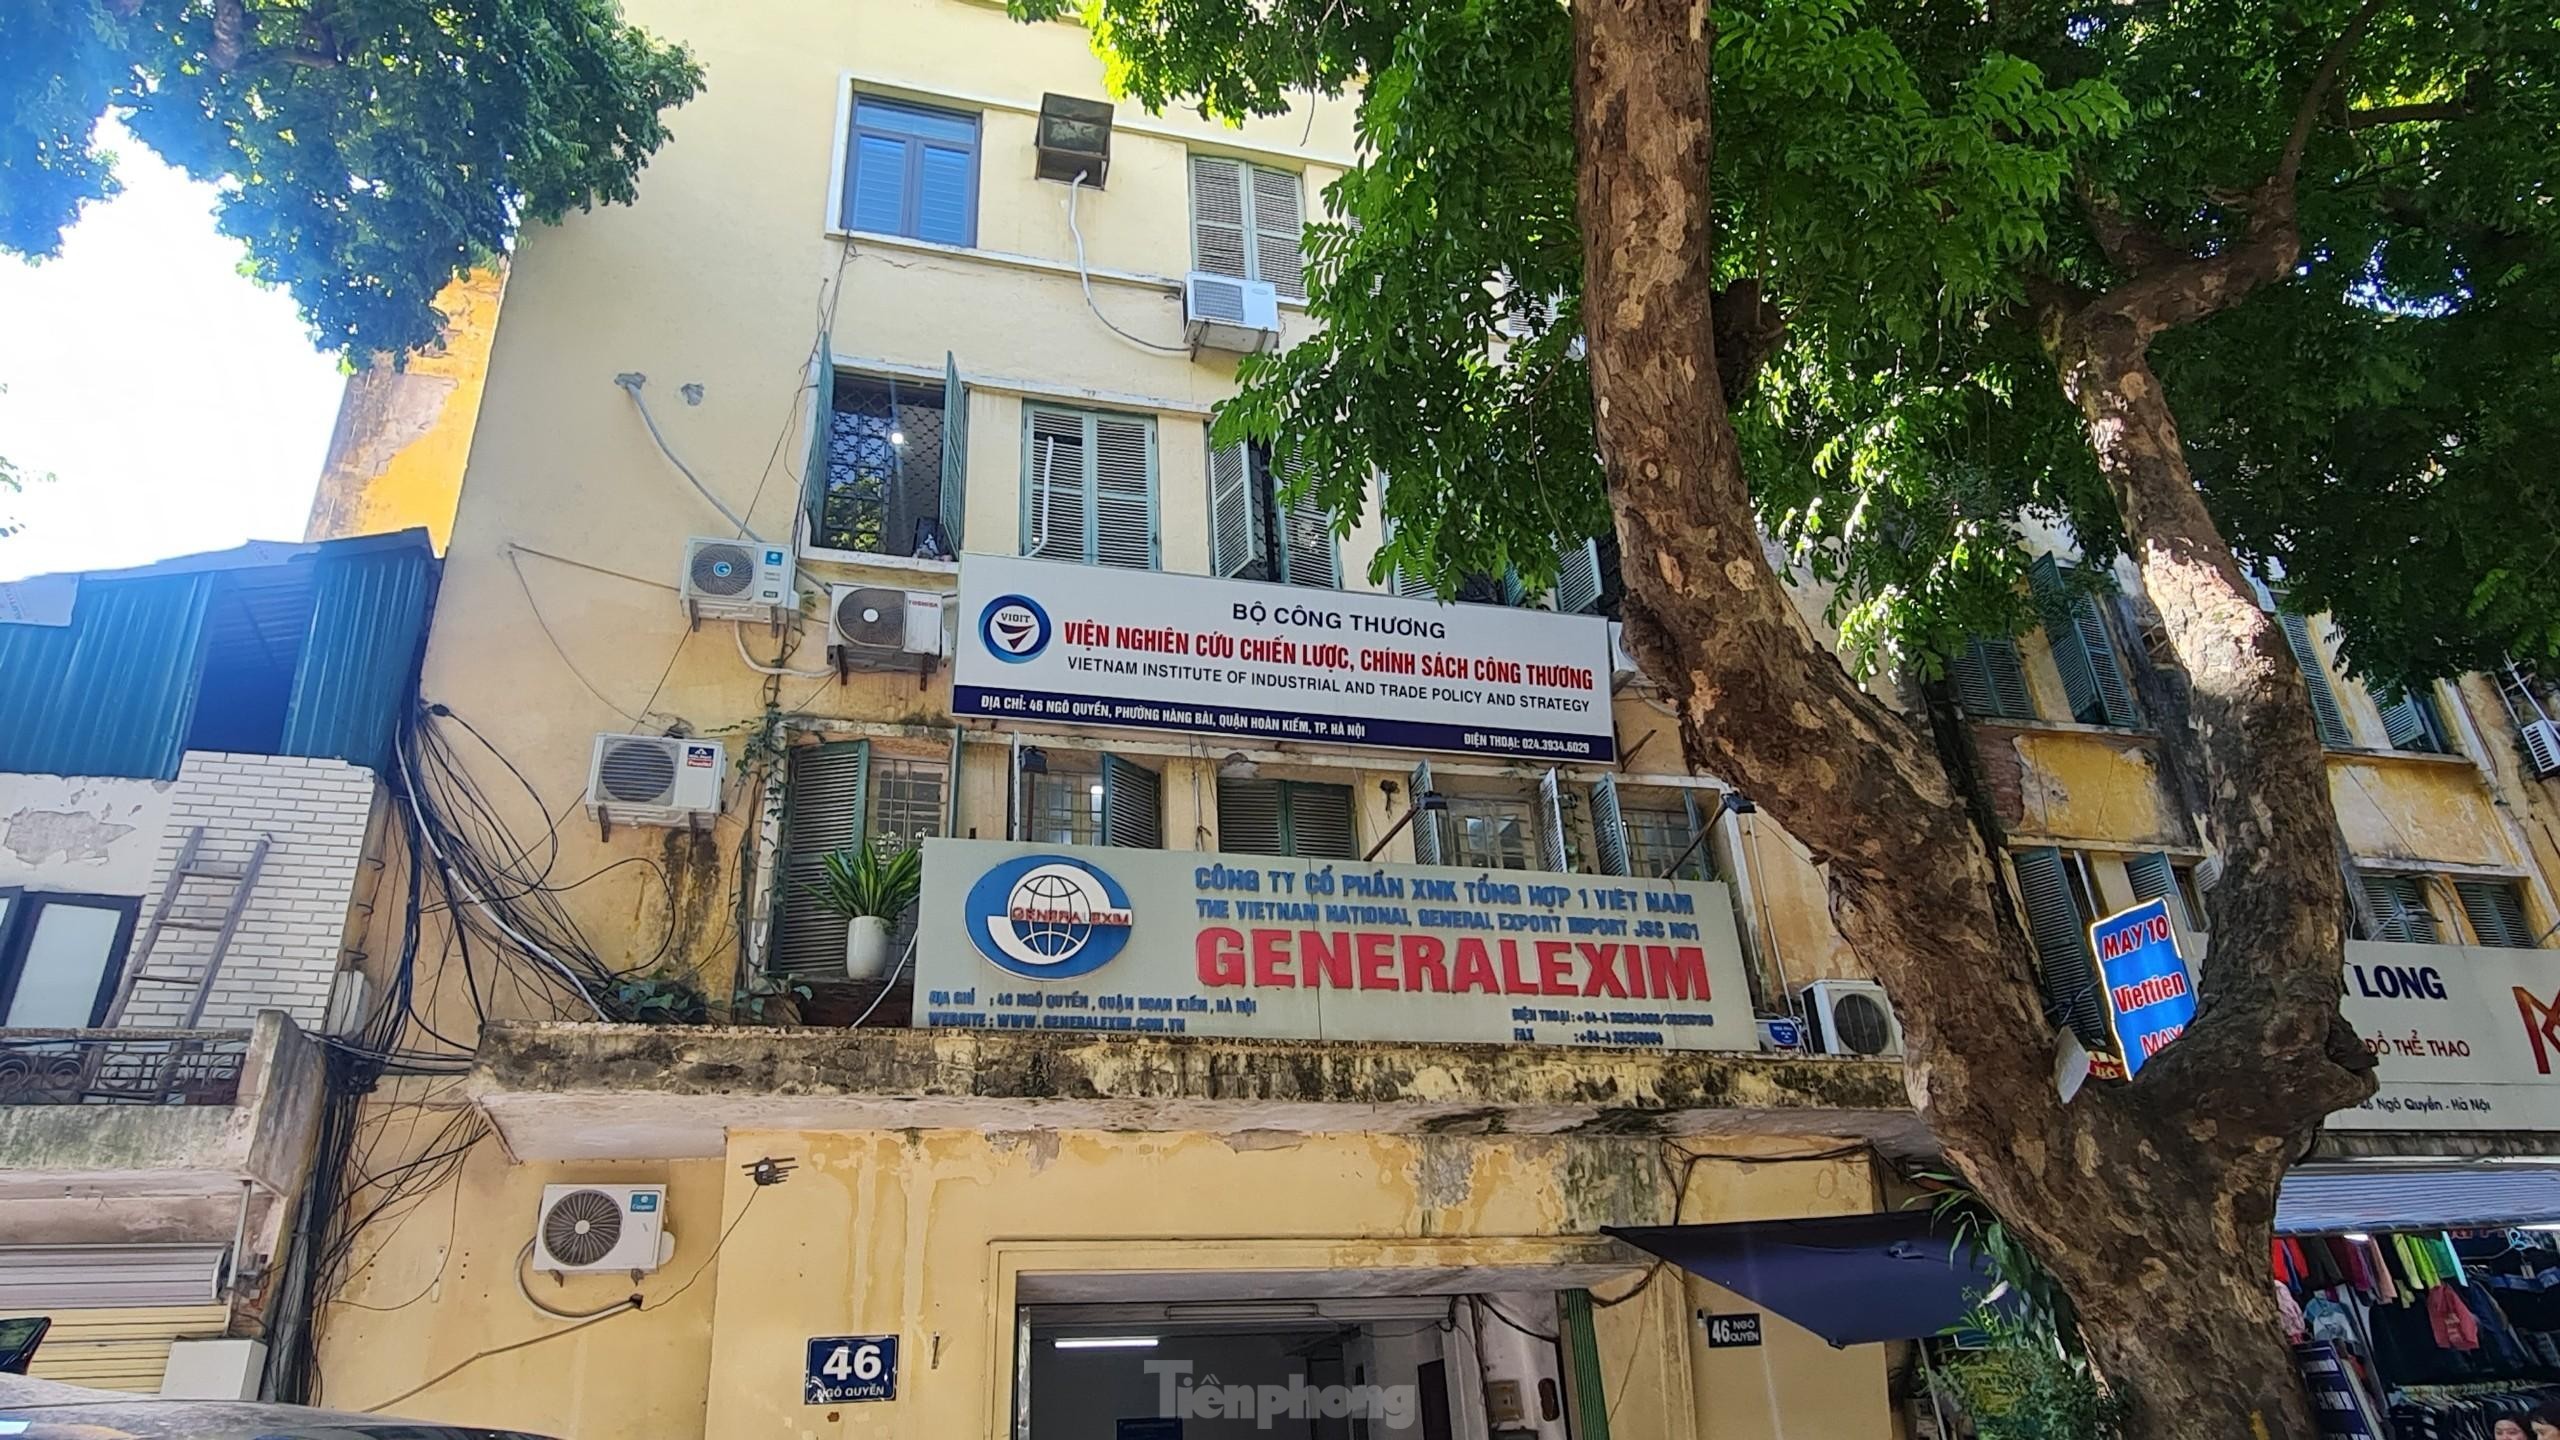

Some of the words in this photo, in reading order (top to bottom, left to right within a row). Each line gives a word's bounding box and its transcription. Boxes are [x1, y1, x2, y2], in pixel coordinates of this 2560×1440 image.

[1000, 612, 1031, 624] VIOIT
[1233, 601, 1267, 626] BỘ
[1274, 605, 1342, 629] CÔNG
[1349, 614, 1446, 639] THƯƠNG
[1064, 619, 1110, 651] VIỆN
[1116, 627, 1190, 655] NGHIÊN
[1196, 631, 1234, 659] CỨU
[1240, 635, 1297, 665] CHIẾN
[1302, 644, 1355, 673] LƯỢC,
[1360, 647, 1416, 675] CHÍNH
[1422, 652, 1468, 680] SÁCH
[1474, 656, 1521, 684] CÔNG
[1526, 664, 1593, 690] THƯƠNG
[1068, 656, 1138, 675] VIETNAM
[1143, 663, 1222, 683] INSTITUTE
[1227, 670, 1247, 685] OF
[1252, 673, 1340, 692] INDUSTRIAL
[1345, 681, 1375, 695] AND
[1379, 683, 1428, 699] TRADE
[1432, 687, 1482, 704] POLICY
[1487, 693, 1515, 706] AND
[1520, 695, 1589, 712] STRATEGY
[981, 695, 1000, 710] ĐỊA
[1003, 694, 1026, 710] CHỈ:
[1029, 699, 1043, 712] 46
[1046, 699, 1070, 713] NGÔ
[1115, 704, 1159, 721] PHƯỜNG
[1163, 708, 1192, 724] HÀNG
[1219, 713, 1248, 730] QUẬN
[1250, 715, 1280, 731] HOÀN
[1282, 717, 1312, 734] KIẾM,
[1314, 721, 1329, 735] TP.
[1330, 721, 1345, 736] HÀ
[1347, 722, 1366, 739] NỘI
[1464, 732, 1488, 748] ĐIỆN
[1489, 735, 1521, 750] THOẠI:
[1195, 863, 1260, 892] CÔNG
[1268, 870, 1296, 894] TY
[1411, 879, 1458, 902] XNK
[1528, 884, 1571, 913] HỢP
[1578, 888, 1589, 910] 1
[1645, 892, 1695, 915] NAM
[1196, 899, 1229, 919] THE
[1235, 901, 1320, 922] VIETNAM
[1497, 913, 1561, 933] EXPORT
[1567, 916, 1627, 937] IMPORT
[1634, 920, 1665, 938] JSC
[2102, 921, 2144, 960] MAY
[2146, 914, 2170, 945] 10
[1195, 926, 1711, 1001] GENERALEXIM
[2113, 971, 2187, 1015] Viettien
[2353, 965, 2448, 1000] LONG
[928, 1011, 986, 1028] WEBSITE
[1514, 1028, 1535, 1041] FAX
[2392, 1028, 2426, 1057] THỂ
[2426, 1040, 2470, 1057] THAO
[2376, 1096, 2402, 1113] Ngô
[2450, 1096, 2469, 1111] Hà
[2470, 1097, 2491, 1113] Nội
[1712, 1319, 1730, 1343] 46
[1732, 1318, 1756, 1330] NGÔ
[822, 1344, 882, 1381] 46
